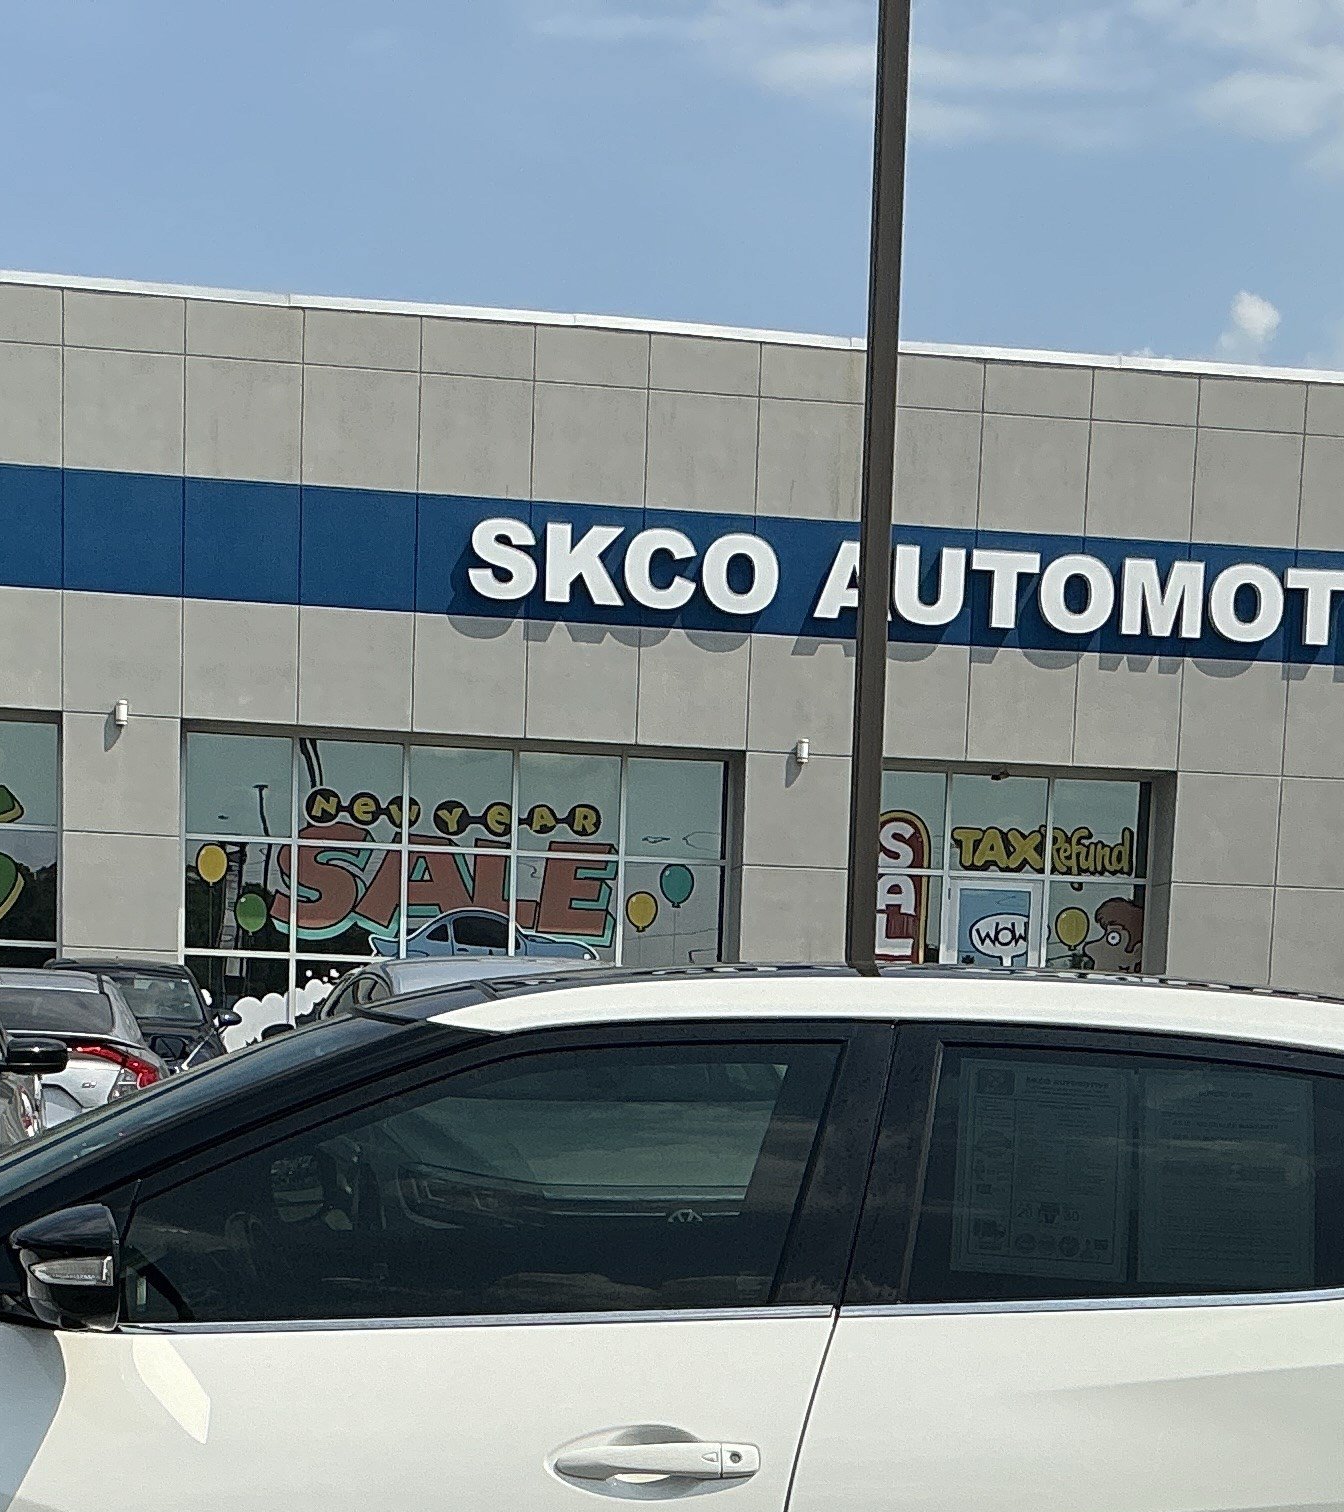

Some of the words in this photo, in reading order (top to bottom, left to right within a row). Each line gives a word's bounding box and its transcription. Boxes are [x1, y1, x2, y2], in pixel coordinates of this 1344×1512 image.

[467, 517, 780, 615] SKCO
[270, 822, 617, 945] SALE
[875, 821, 915, 963] SAL
[953, 827, 1044, 870] TAX
[975, 921, 1028, 946] WOW
